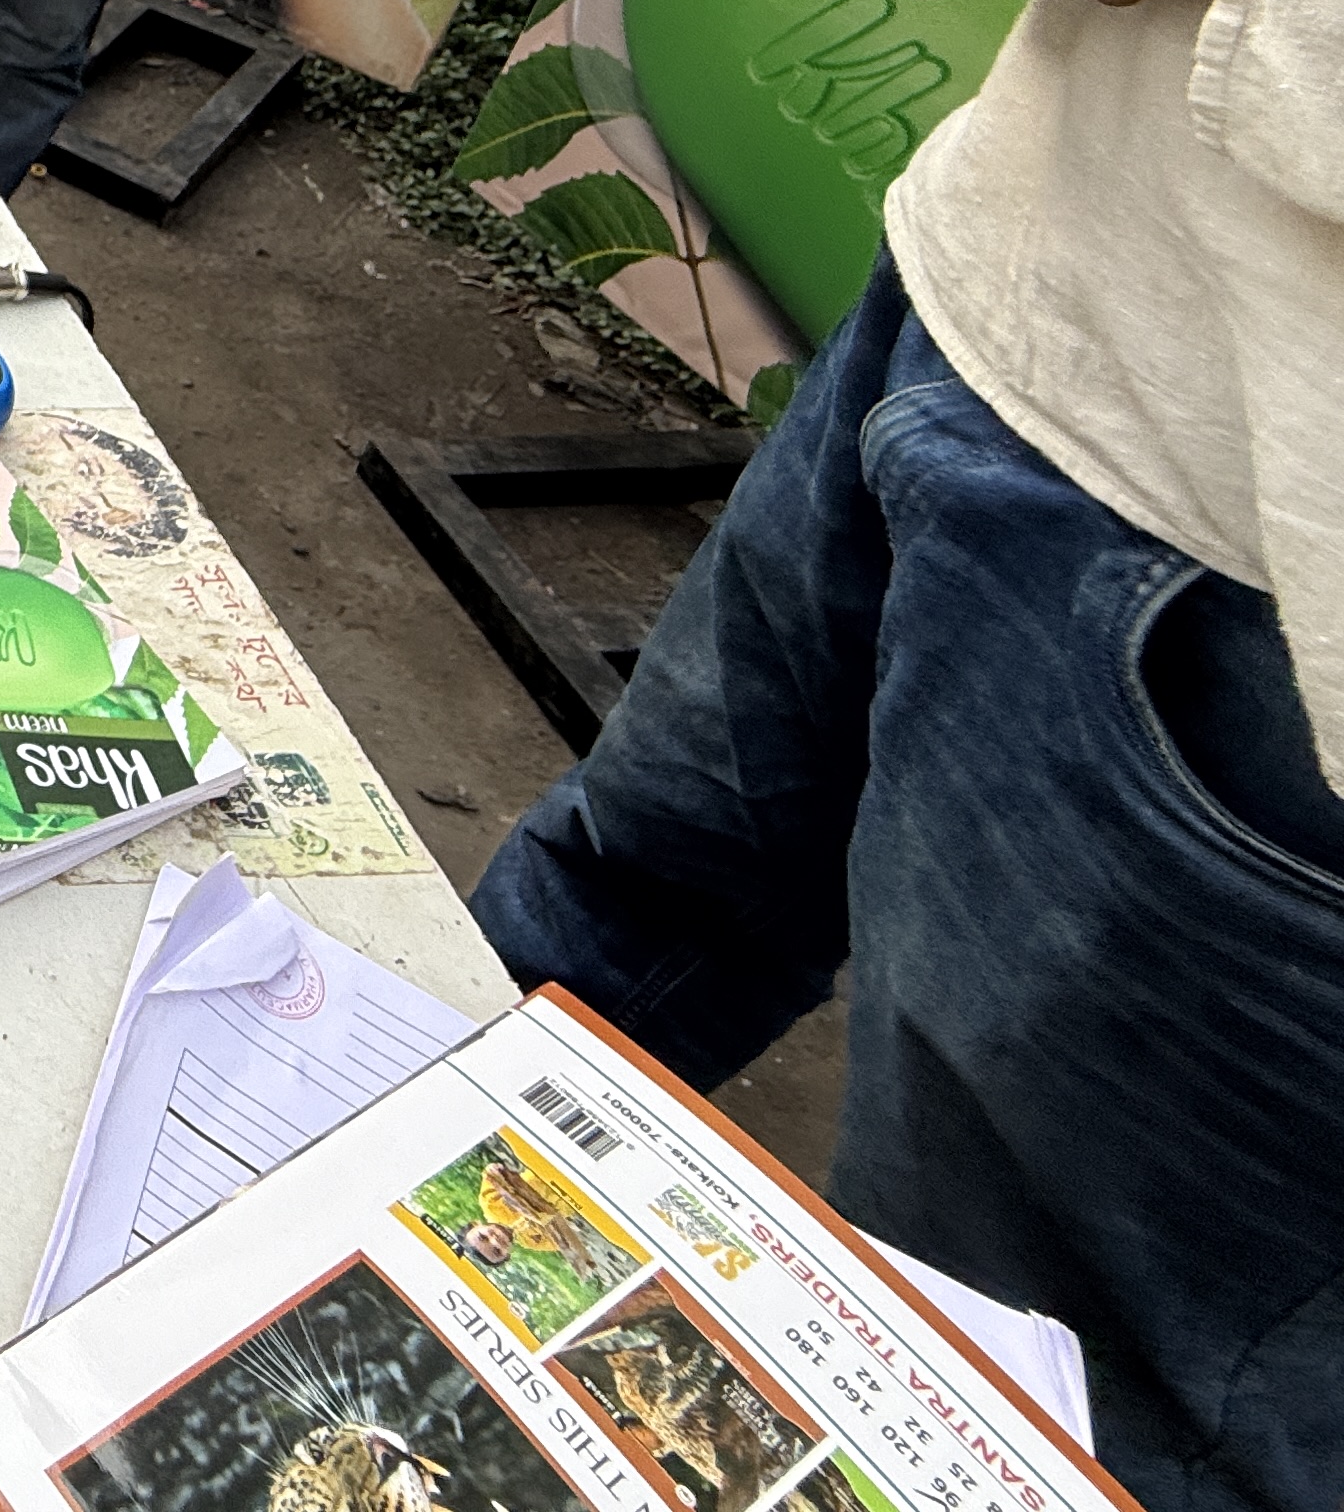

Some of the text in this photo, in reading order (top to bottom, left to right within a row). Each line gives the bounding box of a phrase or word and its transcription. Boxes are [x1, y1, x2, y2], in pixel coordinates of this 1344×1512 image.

[2, 712, 69, 734] neem
[16, 743, 162, 810] Khas
[601, 1092, 663, 1144] 700001
[749, 1214, 898, 1368] TRADERS,
[439, 1289, 627, 1501] THIS SERIES
[784, 1326, 962, 1510] 96 120 160 180
[806, 1319, 979, 1492] 25 32 42 50
[909, 1365, 1047, 1512] SANTRA
